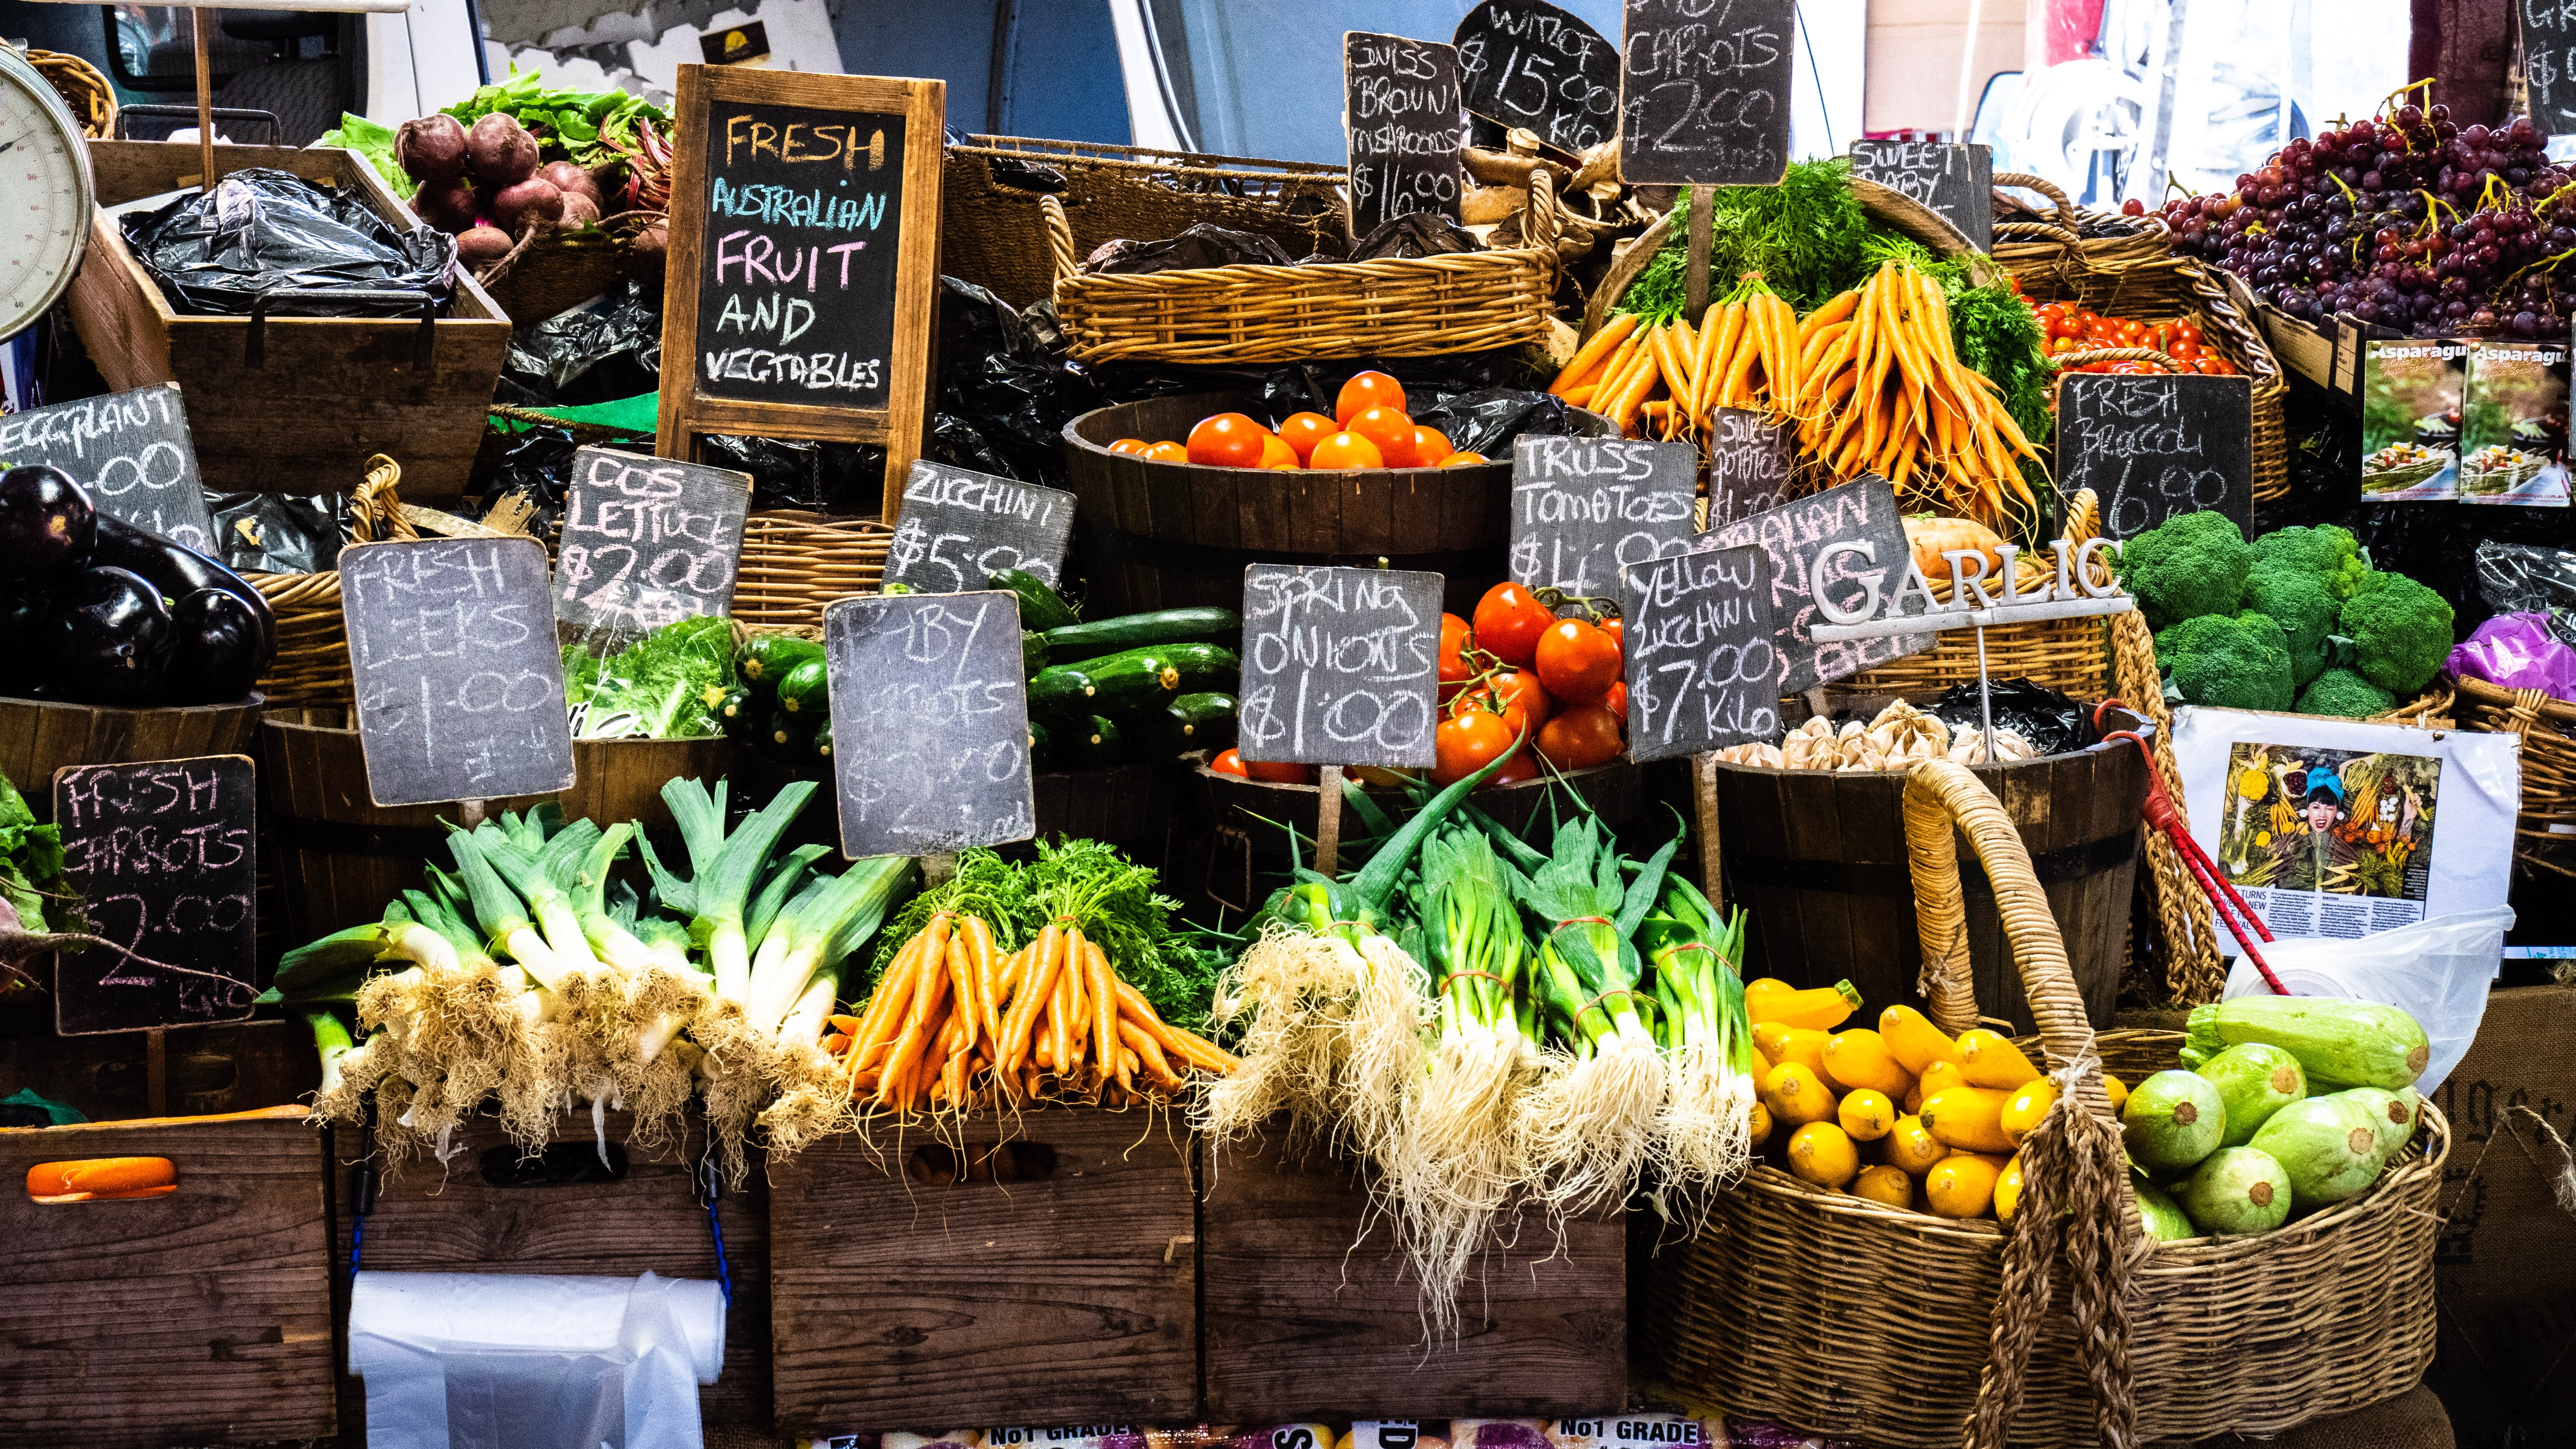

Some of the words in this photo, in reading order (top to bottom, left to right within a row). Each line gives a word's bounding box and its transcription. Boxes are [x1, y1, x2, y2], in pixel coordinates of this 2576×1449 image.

[1354, 76, 1447, 119] BROWN
[727, 115, 885, 171] FRESH
[1849, 142, 1953, 174] SWEET
[713, 177, 887, 232] AUSTRALIAN
[717, 230, 867, 292] FRUIT
[716, 293, 816, 346] AND
[2369, 346, 2468, 361] Asparagu
[2472, 346, 2572, 366] Asparagu
[2073, 377, 2178, 419] FRESH
[587, 457, 684, 498] COS
[1517, 437, 1655, 481] TRUSS
[568, 490, 736, 550] LETTUCE
[1810, 537, 2123, 626] GARLIC
[2241, 889, 2266, 900] TURNS
[2249, 900, 2266, 910] NEW
[1560, 1419, 1604, 1438] No1
[1616, 1421, 1698, 1444] GRADE
